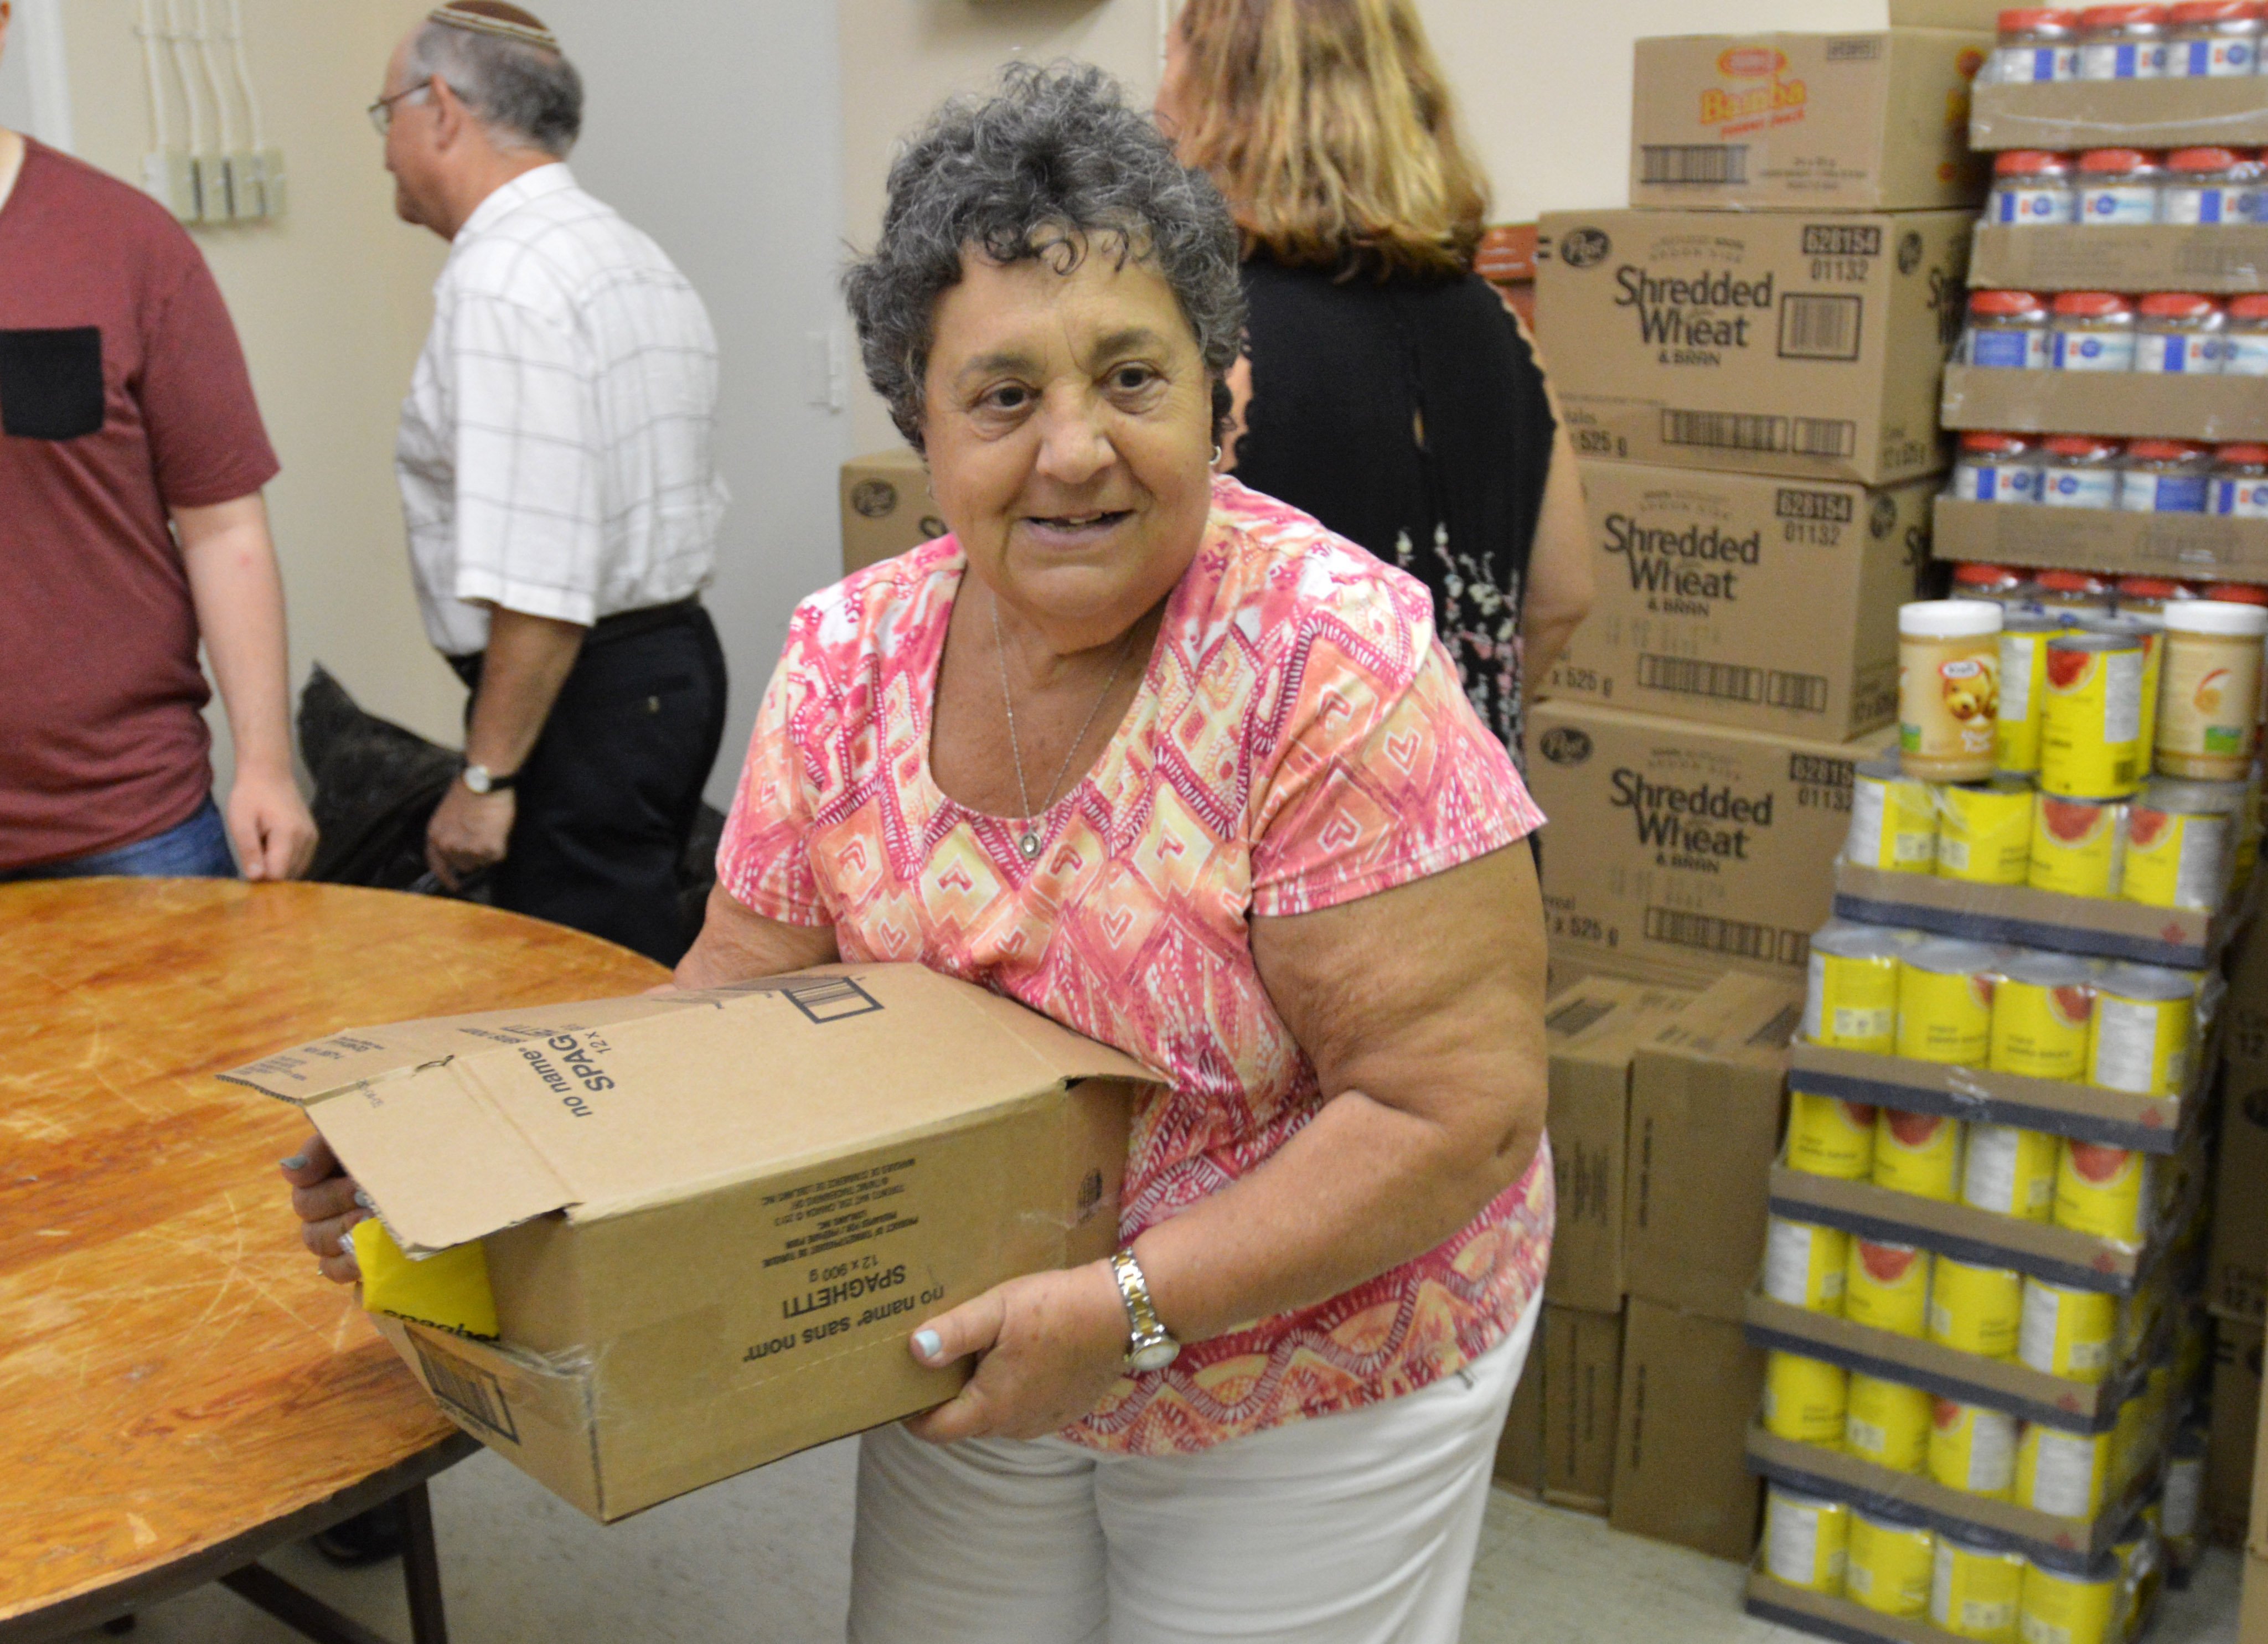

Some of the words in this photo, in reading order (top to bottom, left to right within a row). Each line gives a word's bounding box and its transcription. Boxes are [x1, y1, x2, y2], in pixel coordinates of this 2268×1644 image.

[1615, 263, 1774, 307] Shredded
[1638, 306, 1750, 348] Wheat
[1604, 511, 1761, 565] Shredded
[1784, 520, 1841, 546] 01132
[1627, 555, 1738, 601] Wheat
[1567, 666, 1598, 691] 525
[1610, 766, 1774, 825] Shredded
[1635, 810, 1751, 861] Wheat
[1570, 917, 1603, 940] 525
[584, 1031, 601, 1040] x
[590, 1039, 612, 1055] 12
[562, 1096, 593, 1118] no
[851, 1260, 859, 1271] x
[862, 1254, 880, 1269] 12
[808, 1268, 819, 1283] g
[782, 1264, 907, 1319] SPAGHETTI
[920, 1285, 945, 1306] no
[801, 1316, 851, 1345] sans
